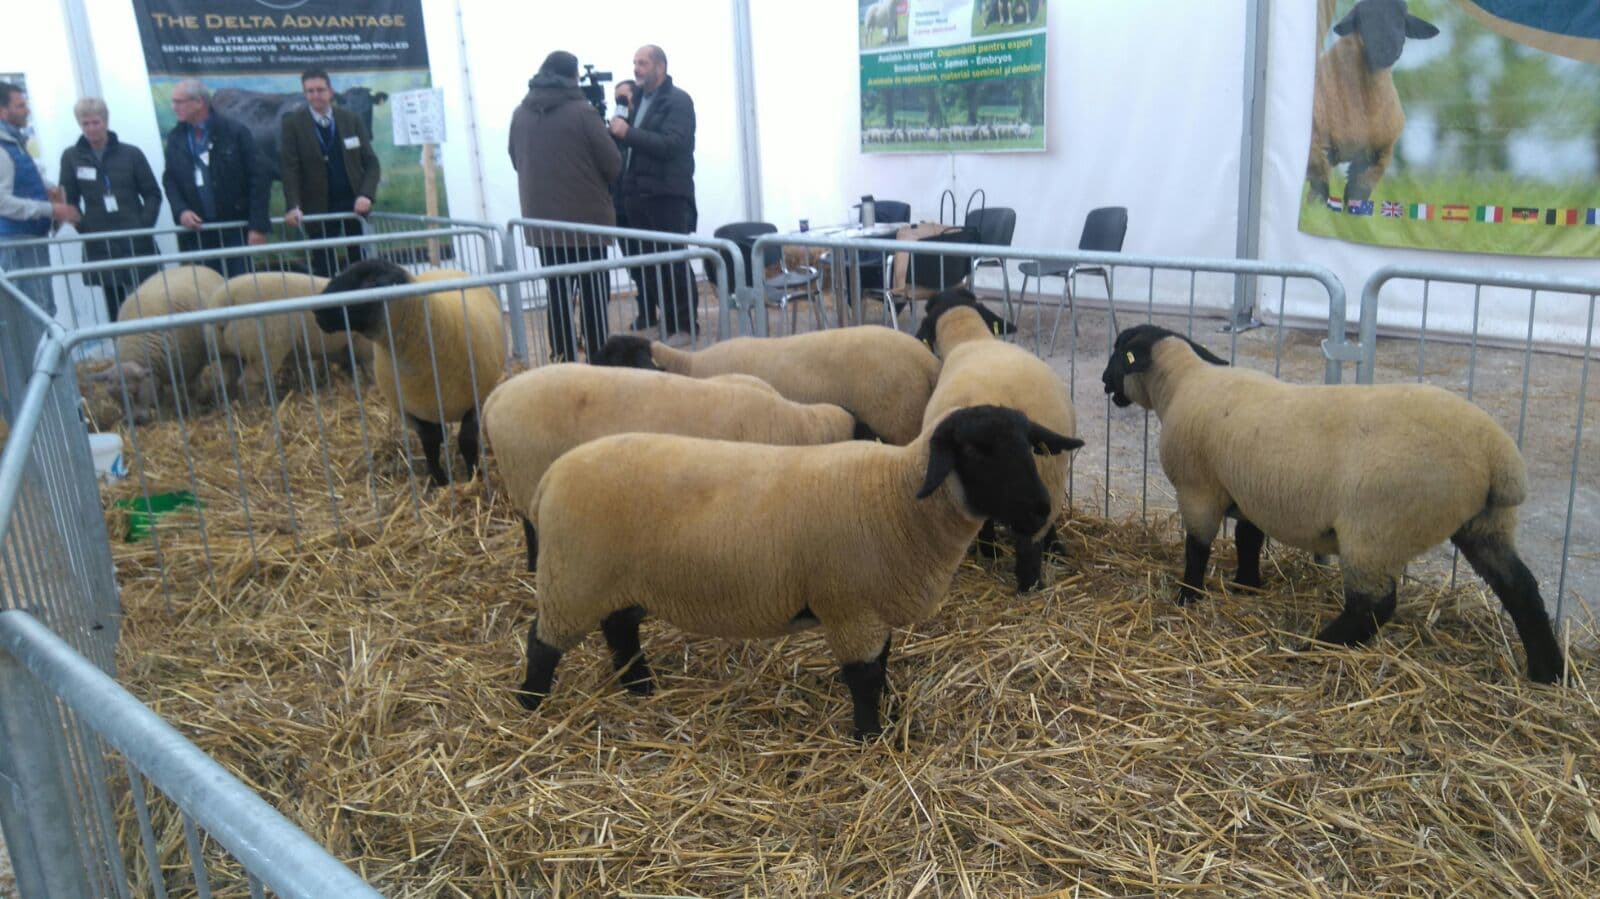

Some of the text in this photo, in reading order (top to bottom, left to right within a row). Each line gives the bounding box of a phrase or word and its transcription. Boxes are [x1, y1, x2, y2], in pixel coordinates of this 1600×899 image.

[152, 12, 406, 29] THE DELTA ADVANTAGE
[246, 35, 310, 43] AUSTRALIAN
[978, 41, 1006, 53] pentru
[1008, 38, 1033, 49] export
[162, 45, 199, 53] SEMEN
[225, 44, 278, 52] EMBRYOS
[290, 43, 349, 51] FULLBLOOD
[373, 42, 409, 50] POLLED
[944, 58, 969, 69] Semen
[976, 53, 1012, 65] Embryos
[972, 67, 1002, 78] seminal
